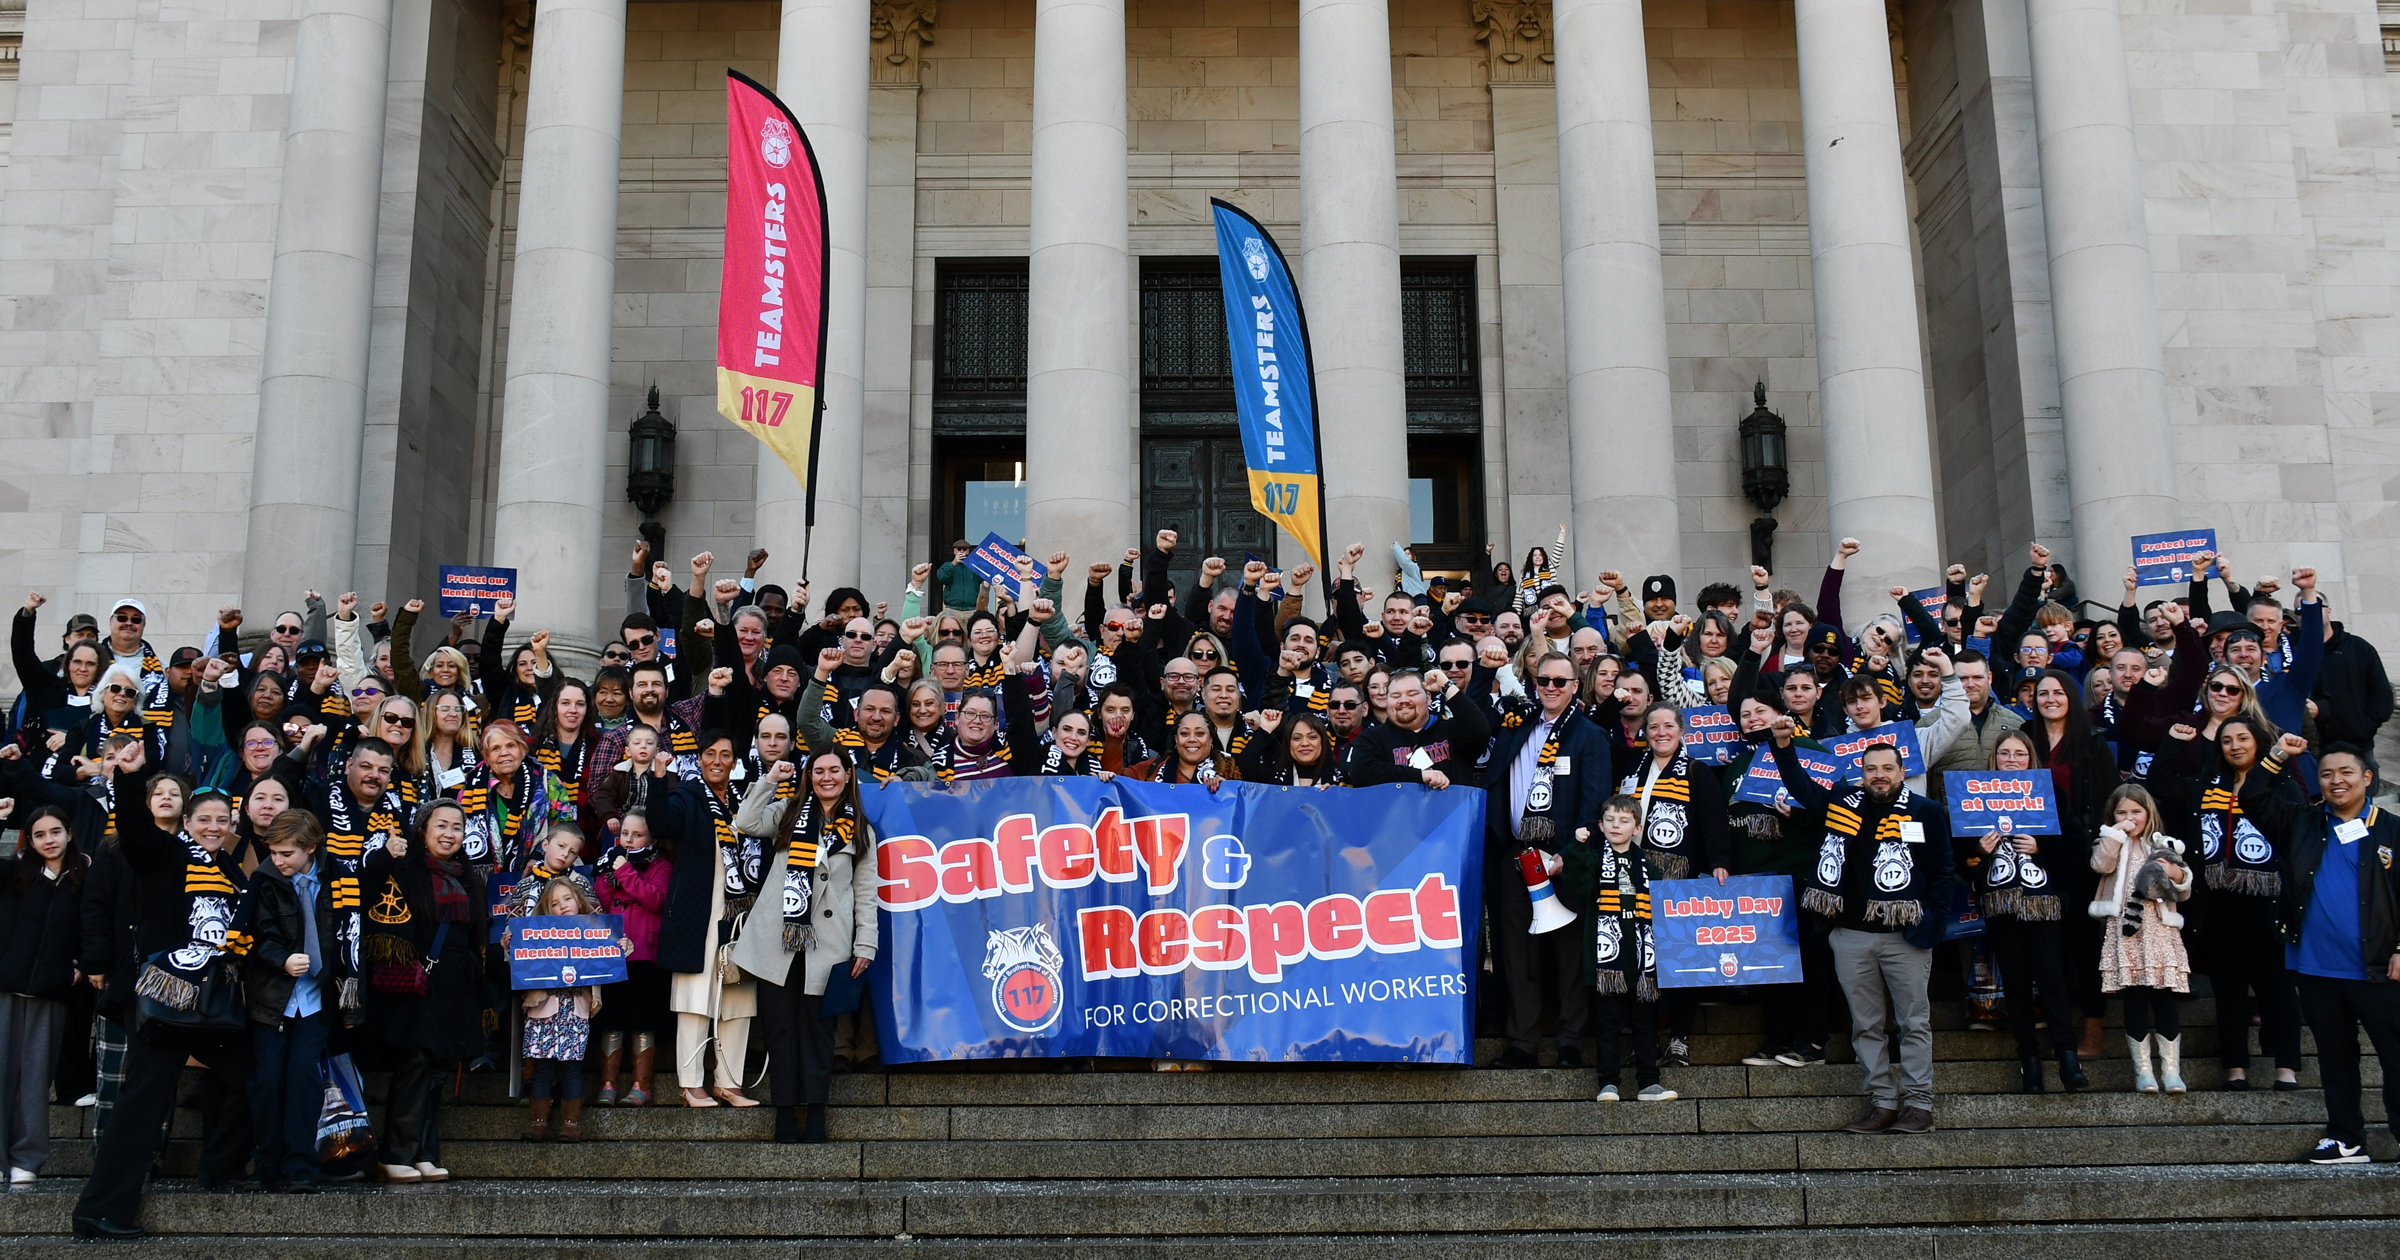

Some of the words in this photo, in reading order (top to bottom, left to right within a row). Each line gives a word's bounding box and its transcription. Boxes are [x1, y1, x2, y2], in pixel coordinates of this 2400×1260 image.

[755, 181, 786, 368] TEAMSTERS
[1251, 294, 1287, 464] TEAMSTERS
[741, 386, 794, 427] 117
[1263, 481, 1300, 515] 117
[2141, 539, 2185, 552] Protect
[2186, 538, 2207, 547] our
[976, 548, 1010, 573] Mental
[988, 542, 1017, 565] Prote
[2136, 553, 2176, 566] Mental
[446, 574, 487, 585] Protect
[488, 577, 508, 586] our
[441, 588, 476, 599] Mental
[477, 590, 513, 600] Health
[1690, 712, 1736, 727] Safe
[1684, 731, 1704, 744] at
[1810, 762, 1836, 773] our
[1966, 779, 2033, 796] Safety
[1531, 792, 1549, 801] 117
[1961, 797, 1985, 811] at
[1986, 796, 2045, 812] work!
[1655, 828, 1675, 838] 117
[2243, 843, 2263, 853] 117
[876, 806, 1191, 912] Safety
[1203, 834, 1252, 890] &
[1884, 870, 1902, 881] 117
[1991, 864, 2006, 877] 117
[2023, 868, 2040, 878] 117
[1663, 896, 1733, 919] Lobby
[1737, 896, 1783, 917] Day
[203, 929, 225, 940] 117
[522, 928, 582, 940] Protect
[584, 928, 611, 939] our
[1076, 872, 1464, 984] Respect
[1696, 925, 1757, 945] 2025
[514, 946, 568, 960] Mental
[570, 946, 621, 959] Health
[1008, 984, 1046, 1008] 117
[1084, 1004, 1126, 1029] FOR
[1132, 986, 1335, 1024] CORRECTIONAL
[1340, 973, 1468, 1004] WORKERS
